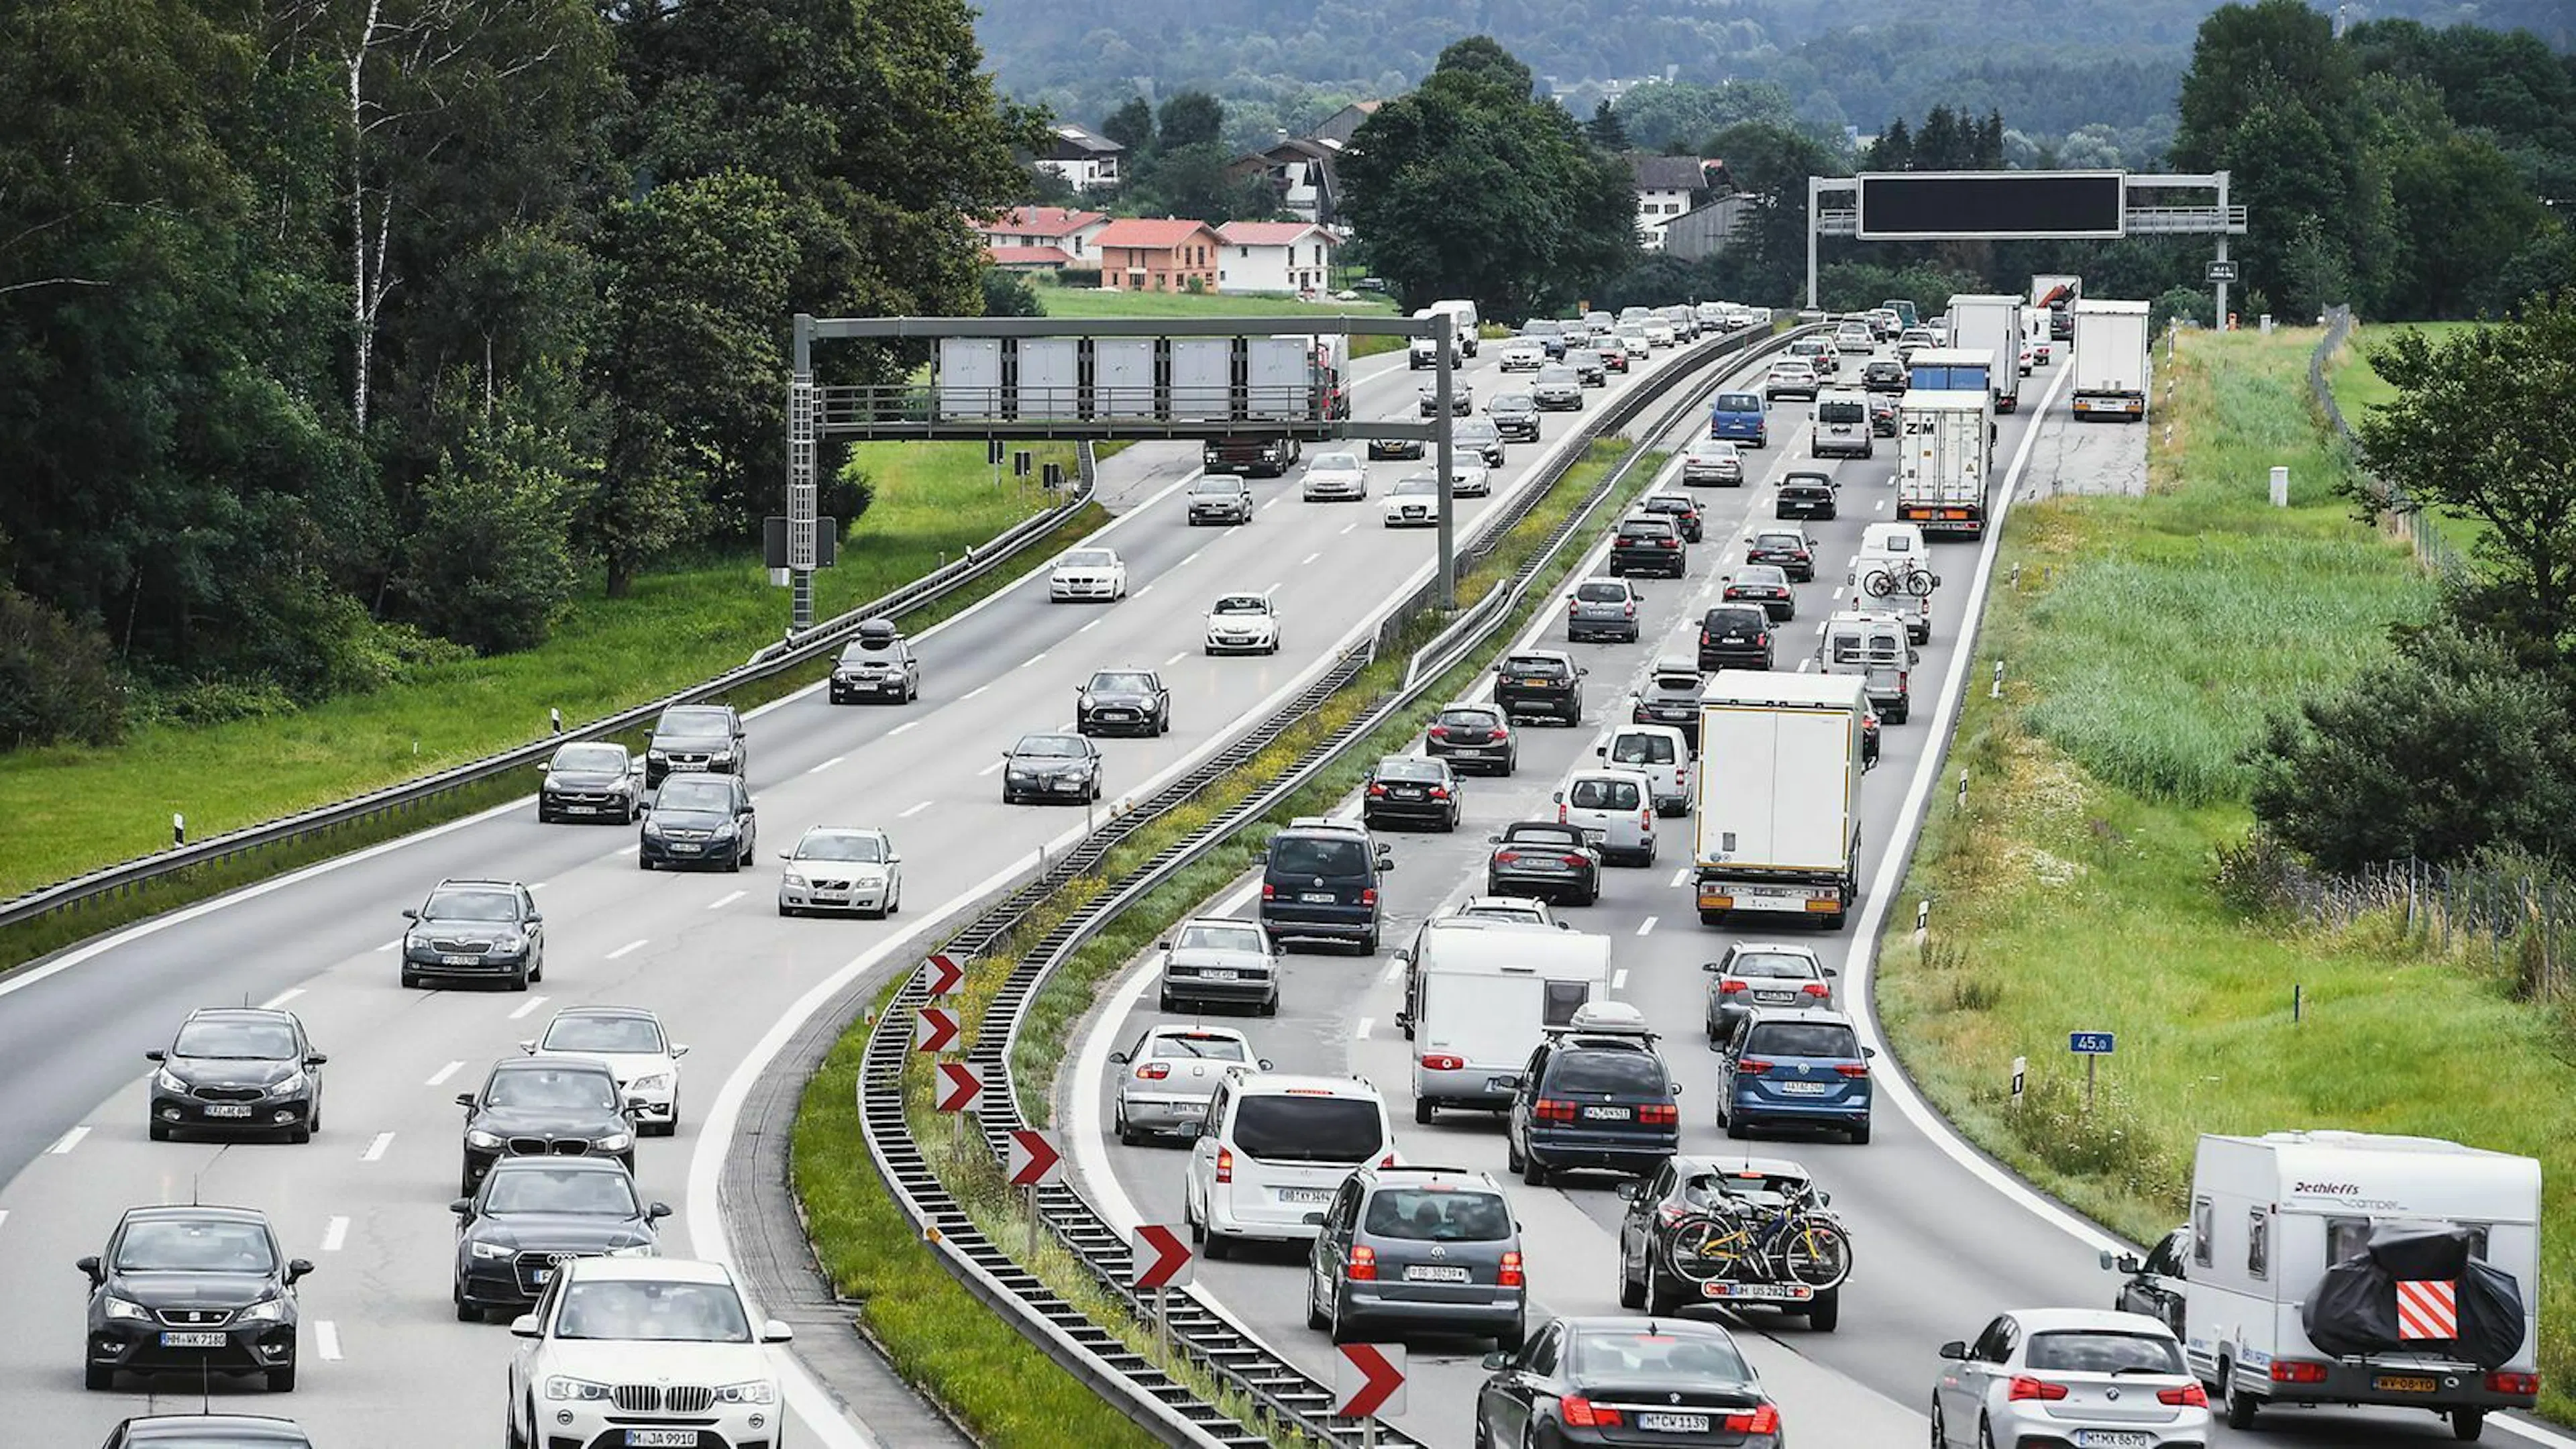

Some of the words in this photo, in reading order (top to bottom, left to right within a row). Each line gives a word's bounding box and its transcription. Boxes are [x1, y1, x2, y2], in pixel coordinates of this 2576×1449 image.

[2078, 1036, 2106, 1051] 45,0
[2294, 1181, 2360, 1195] Dethleffs
[2350, 1199, 2399, 1210] camper
